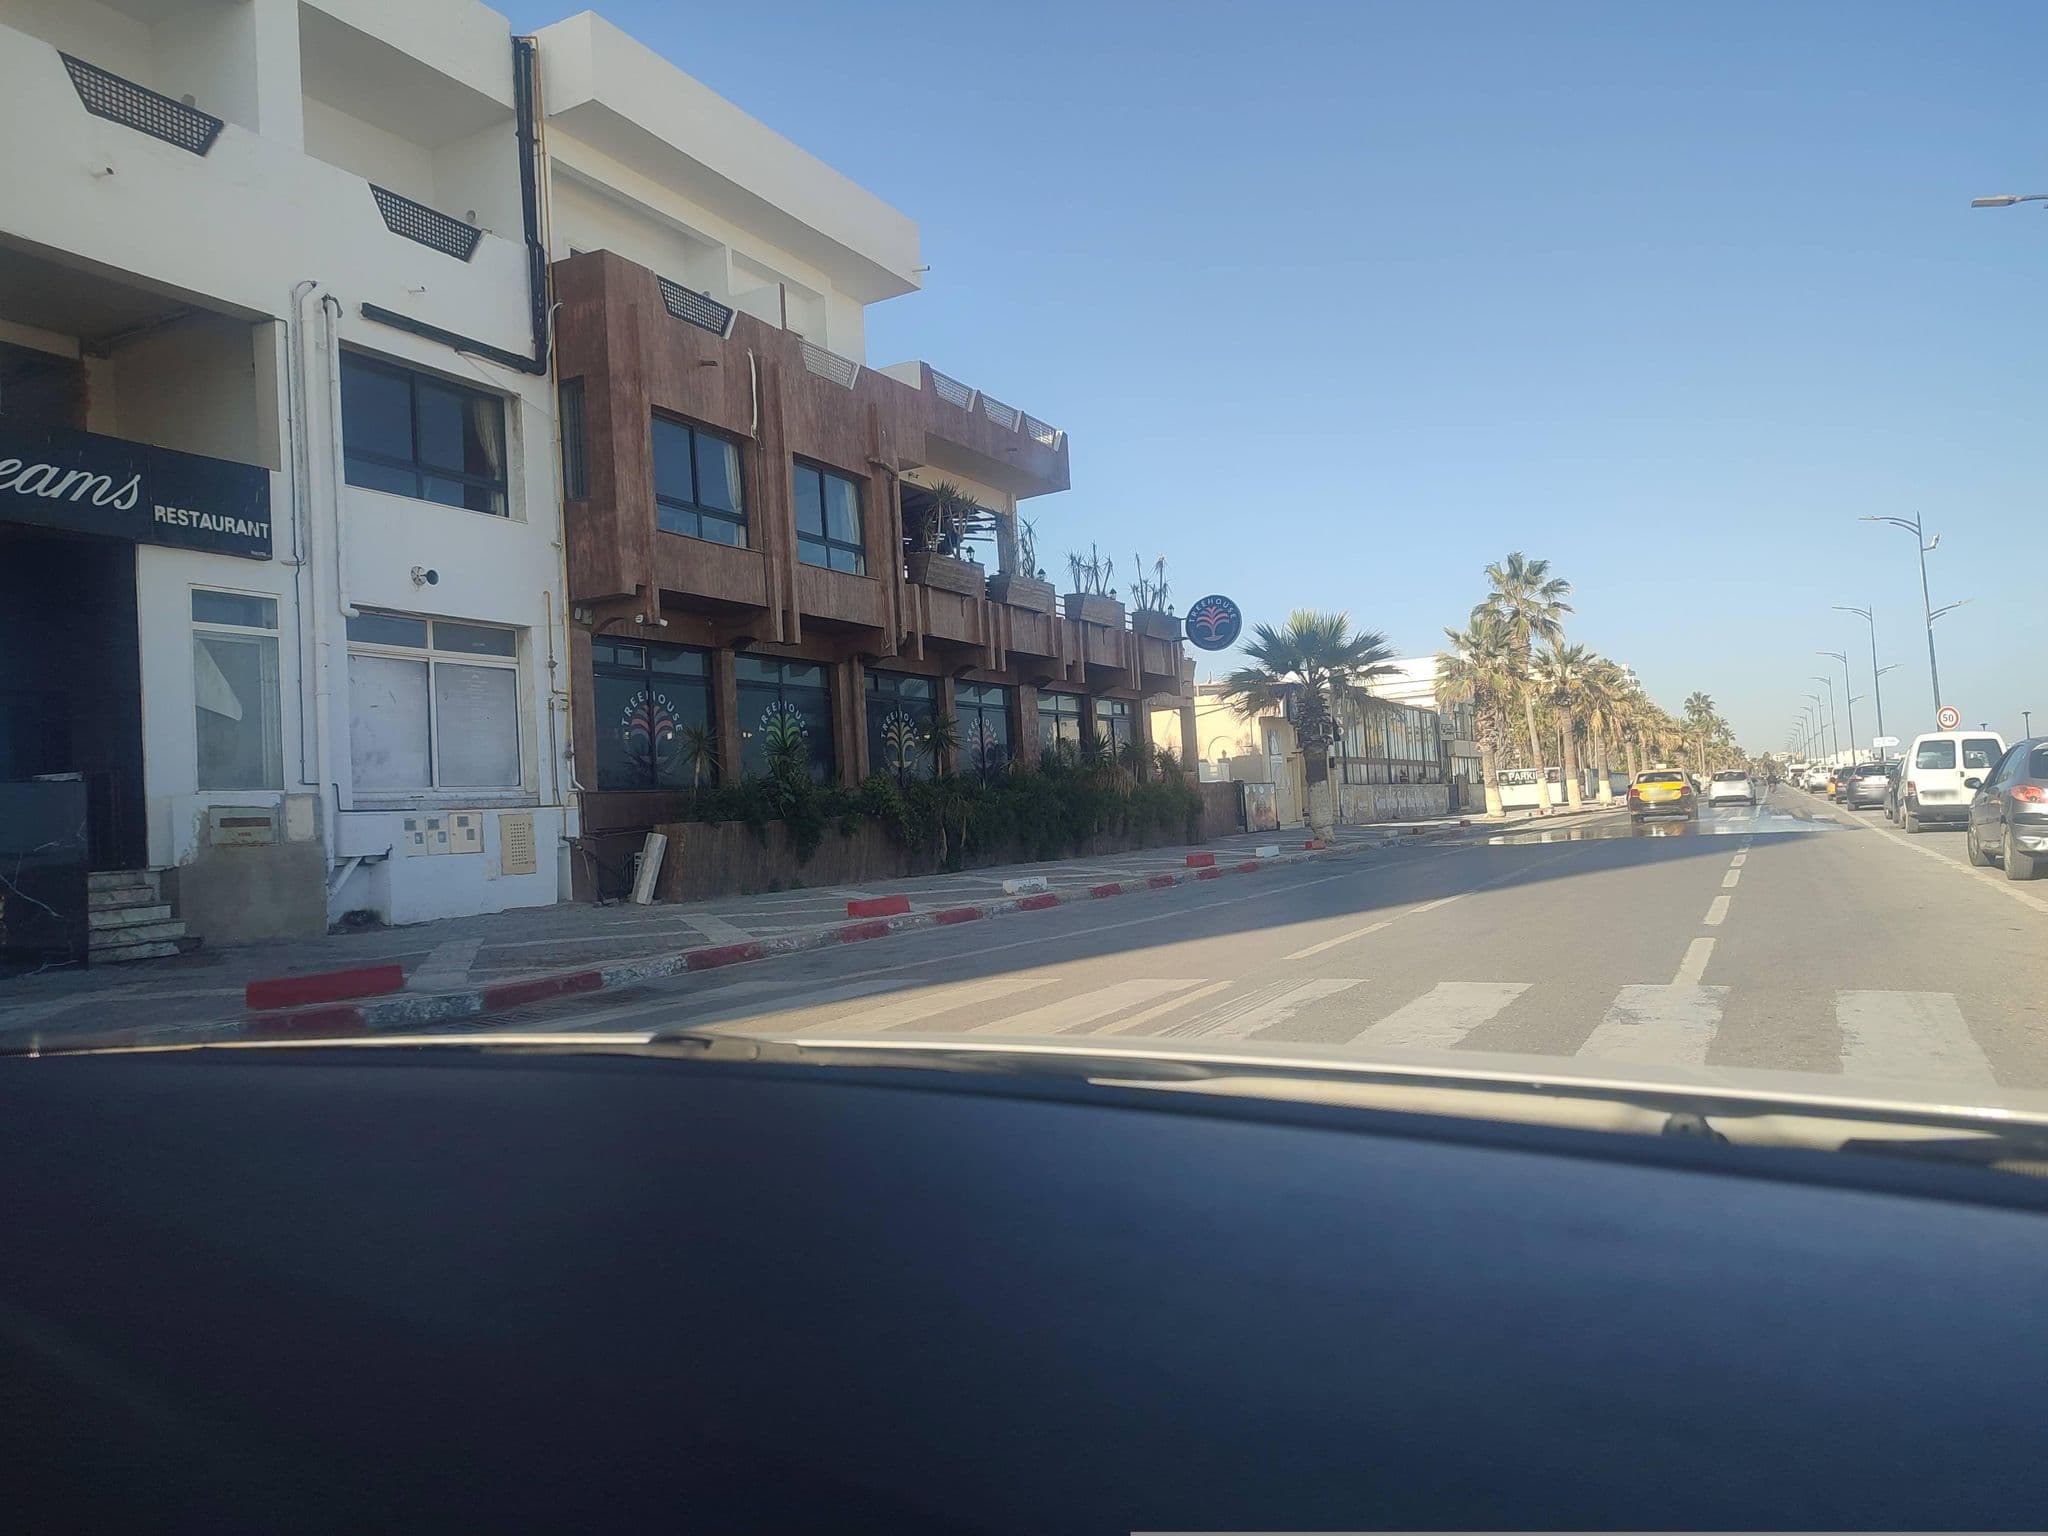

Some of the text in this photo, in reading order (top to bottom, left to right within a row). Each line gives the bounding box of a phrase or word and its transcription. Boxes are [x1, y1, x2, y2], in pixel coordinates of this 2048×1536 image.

[0, 458, 141, 510] eams
[154, 504, 269, 539] RESTAURANT
[1188, 598, 1237, 623] TREEHOUSE
[621, 690, 684, 732] TREEHOUSE
[759, 700, 809, 738] TREEHOUSE
[1942, 713, 1954, 722] 50
